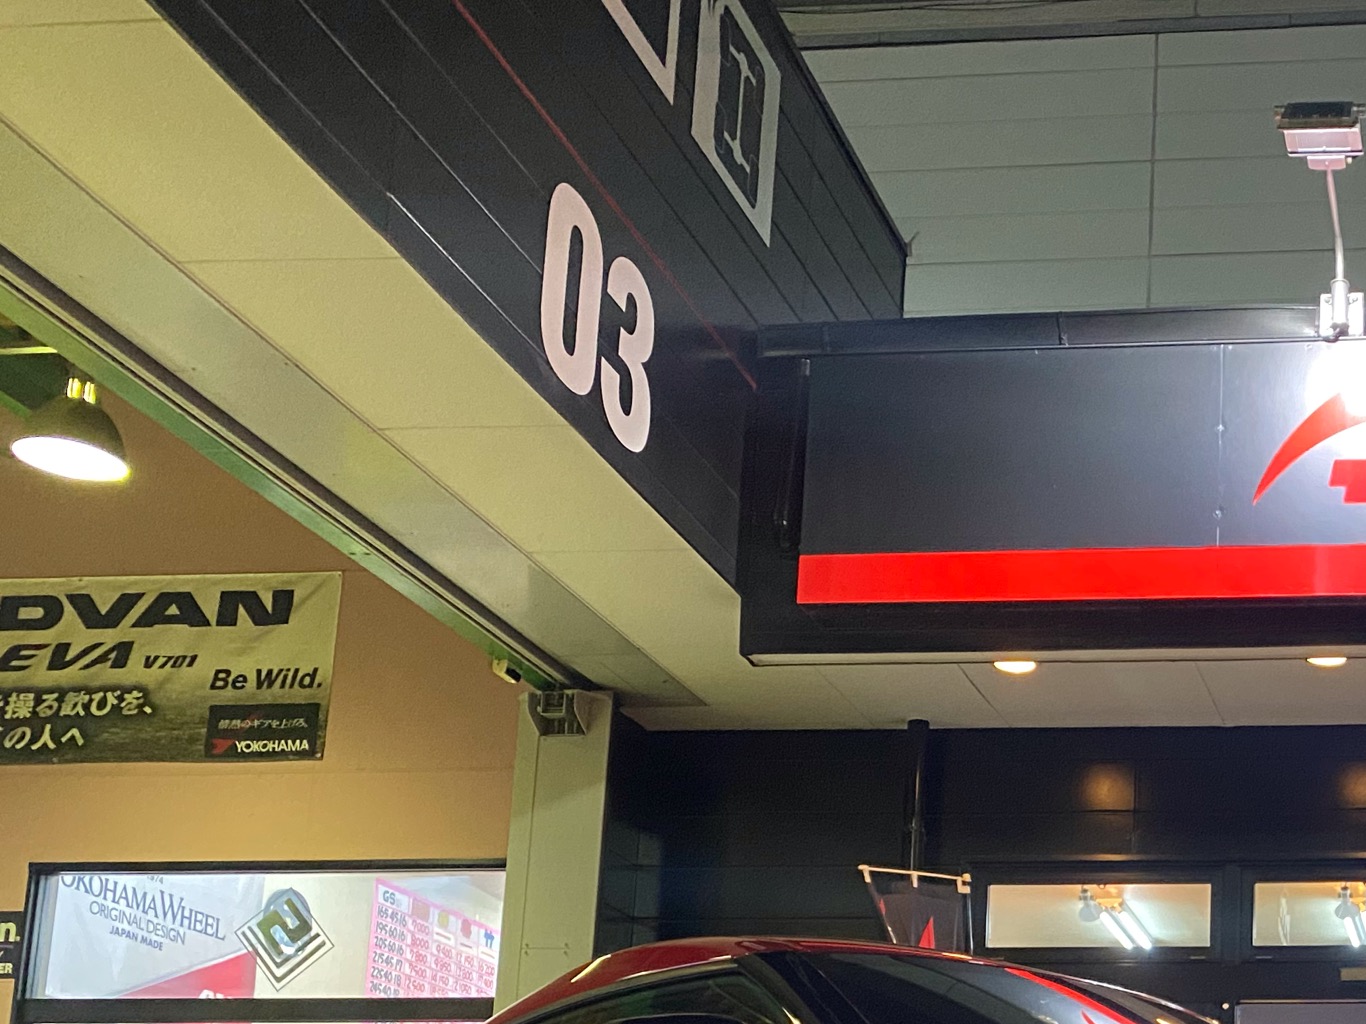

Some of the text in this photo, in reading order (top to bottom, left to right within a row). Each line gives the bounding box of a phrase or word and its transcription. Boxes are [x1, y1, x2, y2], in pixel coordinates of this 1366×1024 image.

[541, 182, 655, 453] 03
[144, 654, 198, 669] V701
[209, 667, 322, 690] Be Wild.
[0, 691, 152, 719] 操る歓びを、
[0, 724, 84, 750] の人へ
[236, 739, 309, 753] YOKOHAMA
[89, 901, 186, 945] ORIGINAL DESIGN
[109, 925, 164, 951] JAPAN MADE
